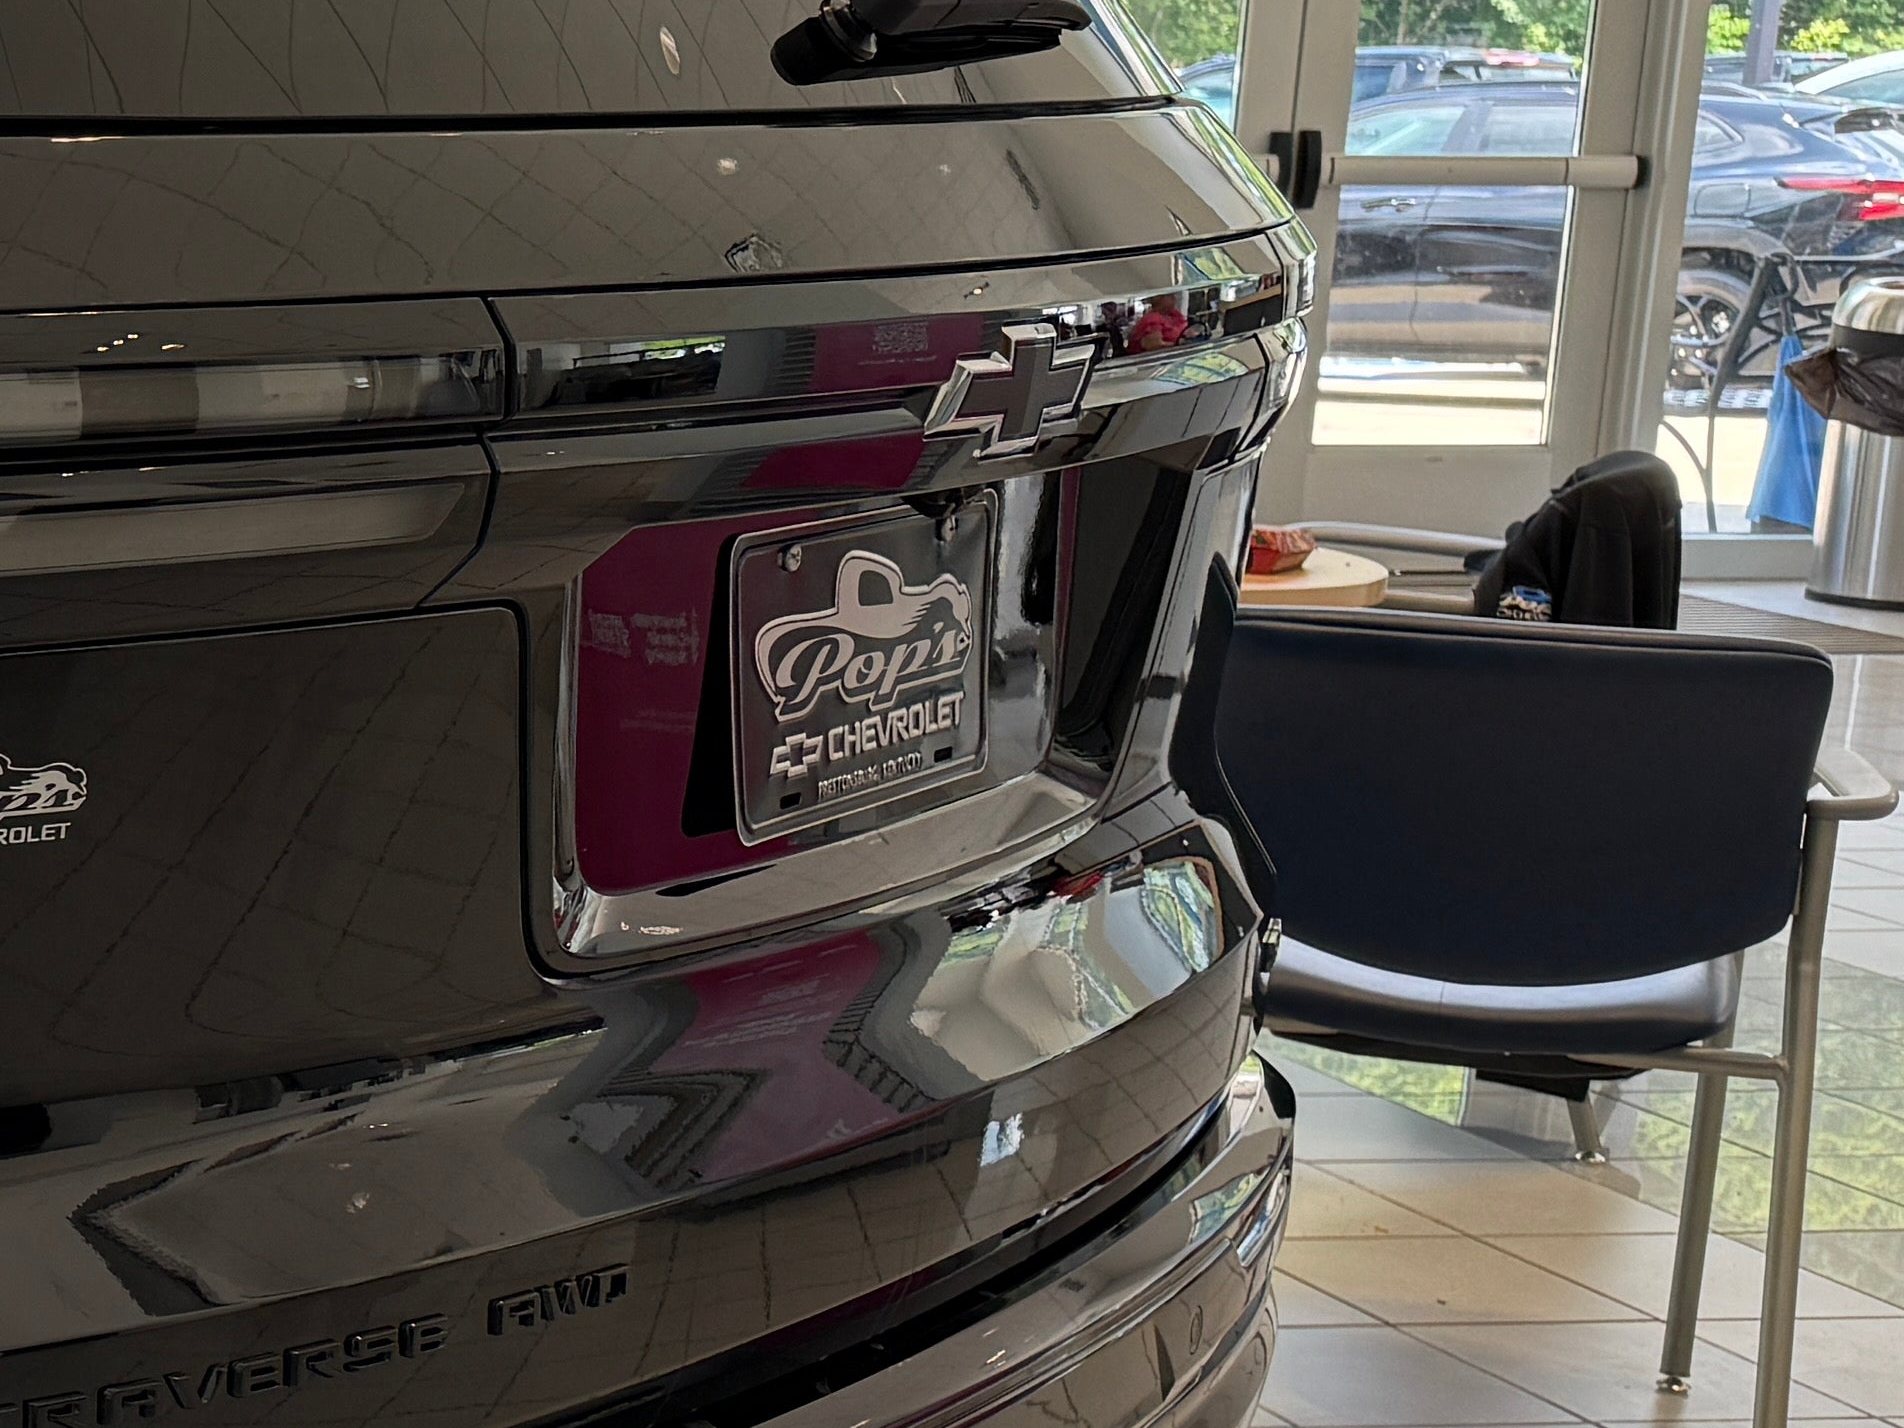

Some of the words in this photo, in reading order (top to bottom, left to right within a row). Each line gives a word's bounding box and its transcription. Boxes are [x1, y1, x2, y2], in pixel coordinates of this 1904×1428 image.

[775, 622, 963, 704] Pop's
[827, 691, 966, 762] CHEVROLET
[487, 1263, 630, 1336] AWD
